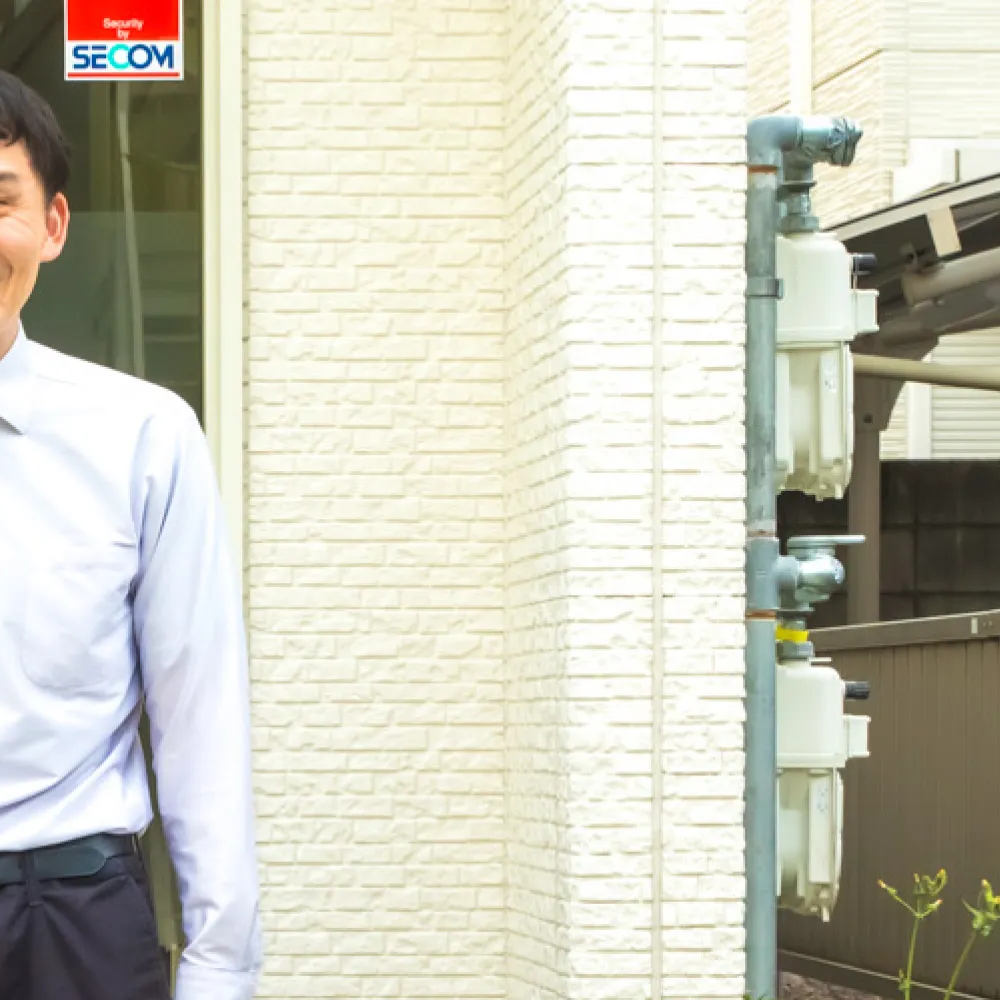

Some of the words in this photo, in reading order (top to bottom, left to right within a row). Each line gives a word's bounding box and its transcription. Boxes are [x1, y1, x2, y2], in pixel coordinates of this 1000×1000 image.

[103, 17, 143, 30] Security
[117, 29, 130, 40] by
[73, 43, 174, 69] SECOM
